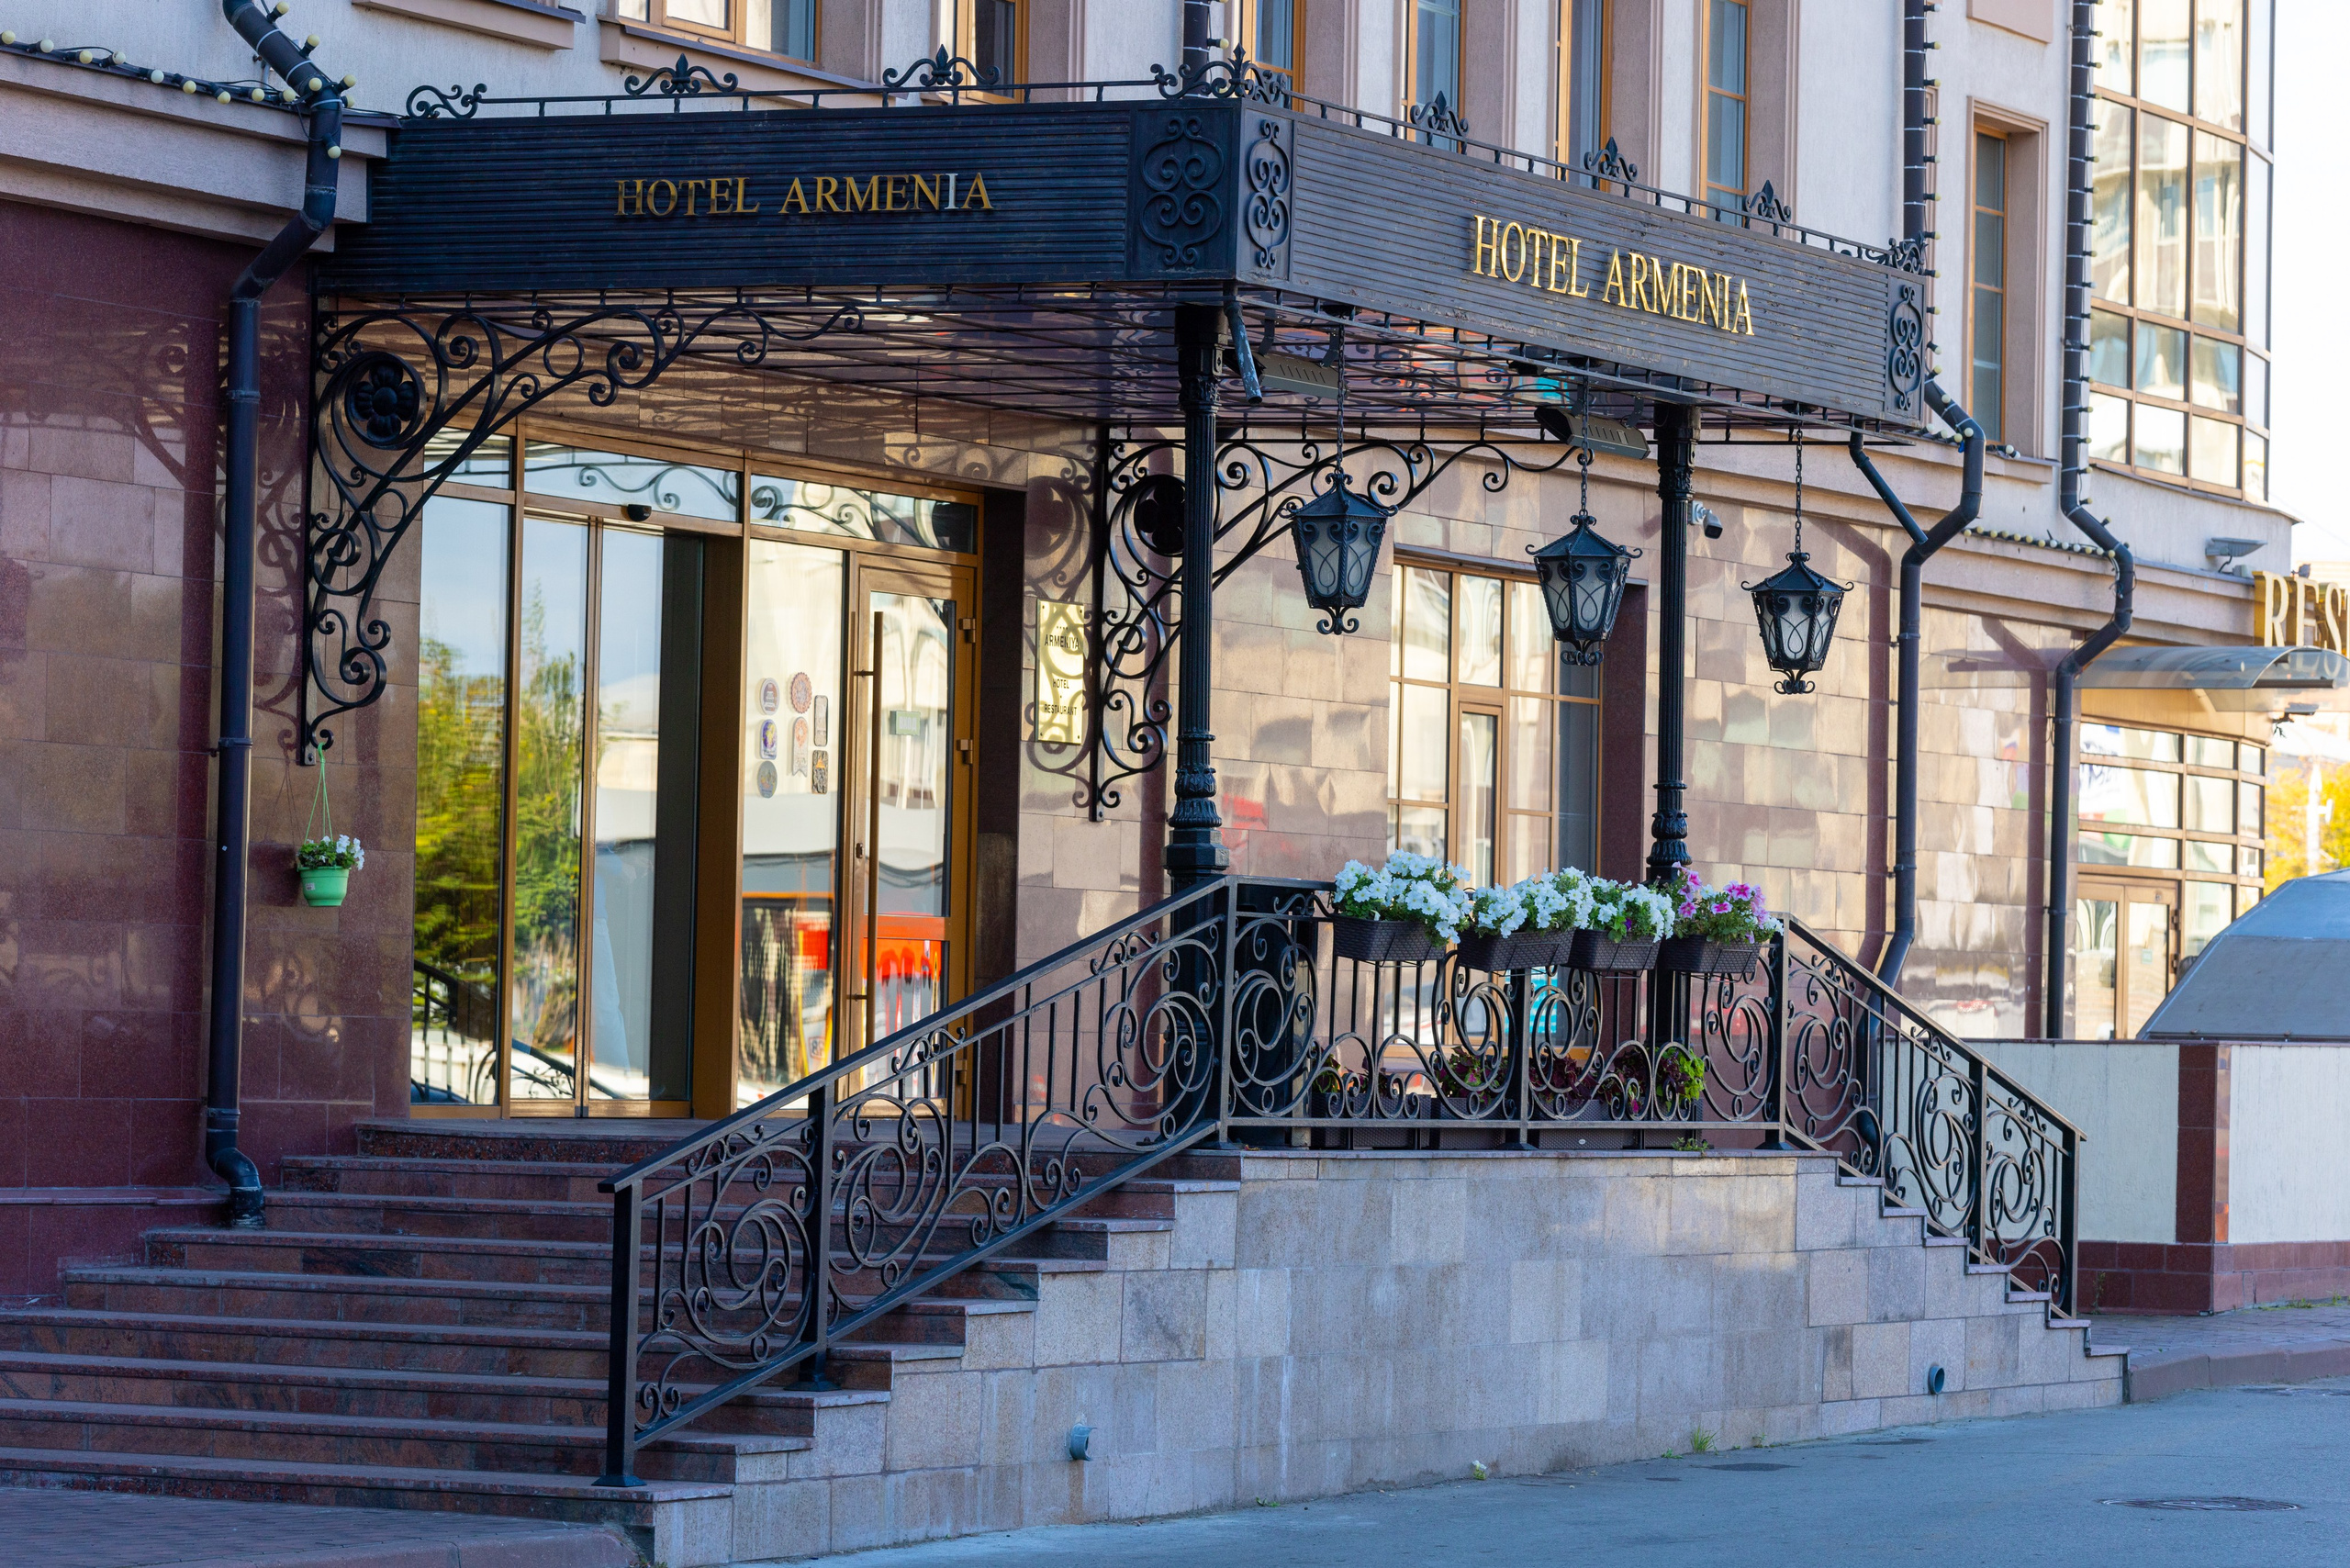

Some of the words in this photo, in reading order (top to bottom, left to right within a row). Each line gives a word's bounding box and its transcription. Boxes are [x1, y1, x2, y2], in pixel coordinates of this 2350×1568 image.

[614, 176, 760, 217] HOTEL
[778, 172, 994, 214] ARMENIA
[1472, 214, 1590, 298] HOTEL
[1602, 247, 1755, 336] ARMENIA
[1044, 634, 1080, 649] ARMENIYA
[1052, 678, 1069, 689] HOTEL
[1044, 703, 1077, 715] RESTAURANT
